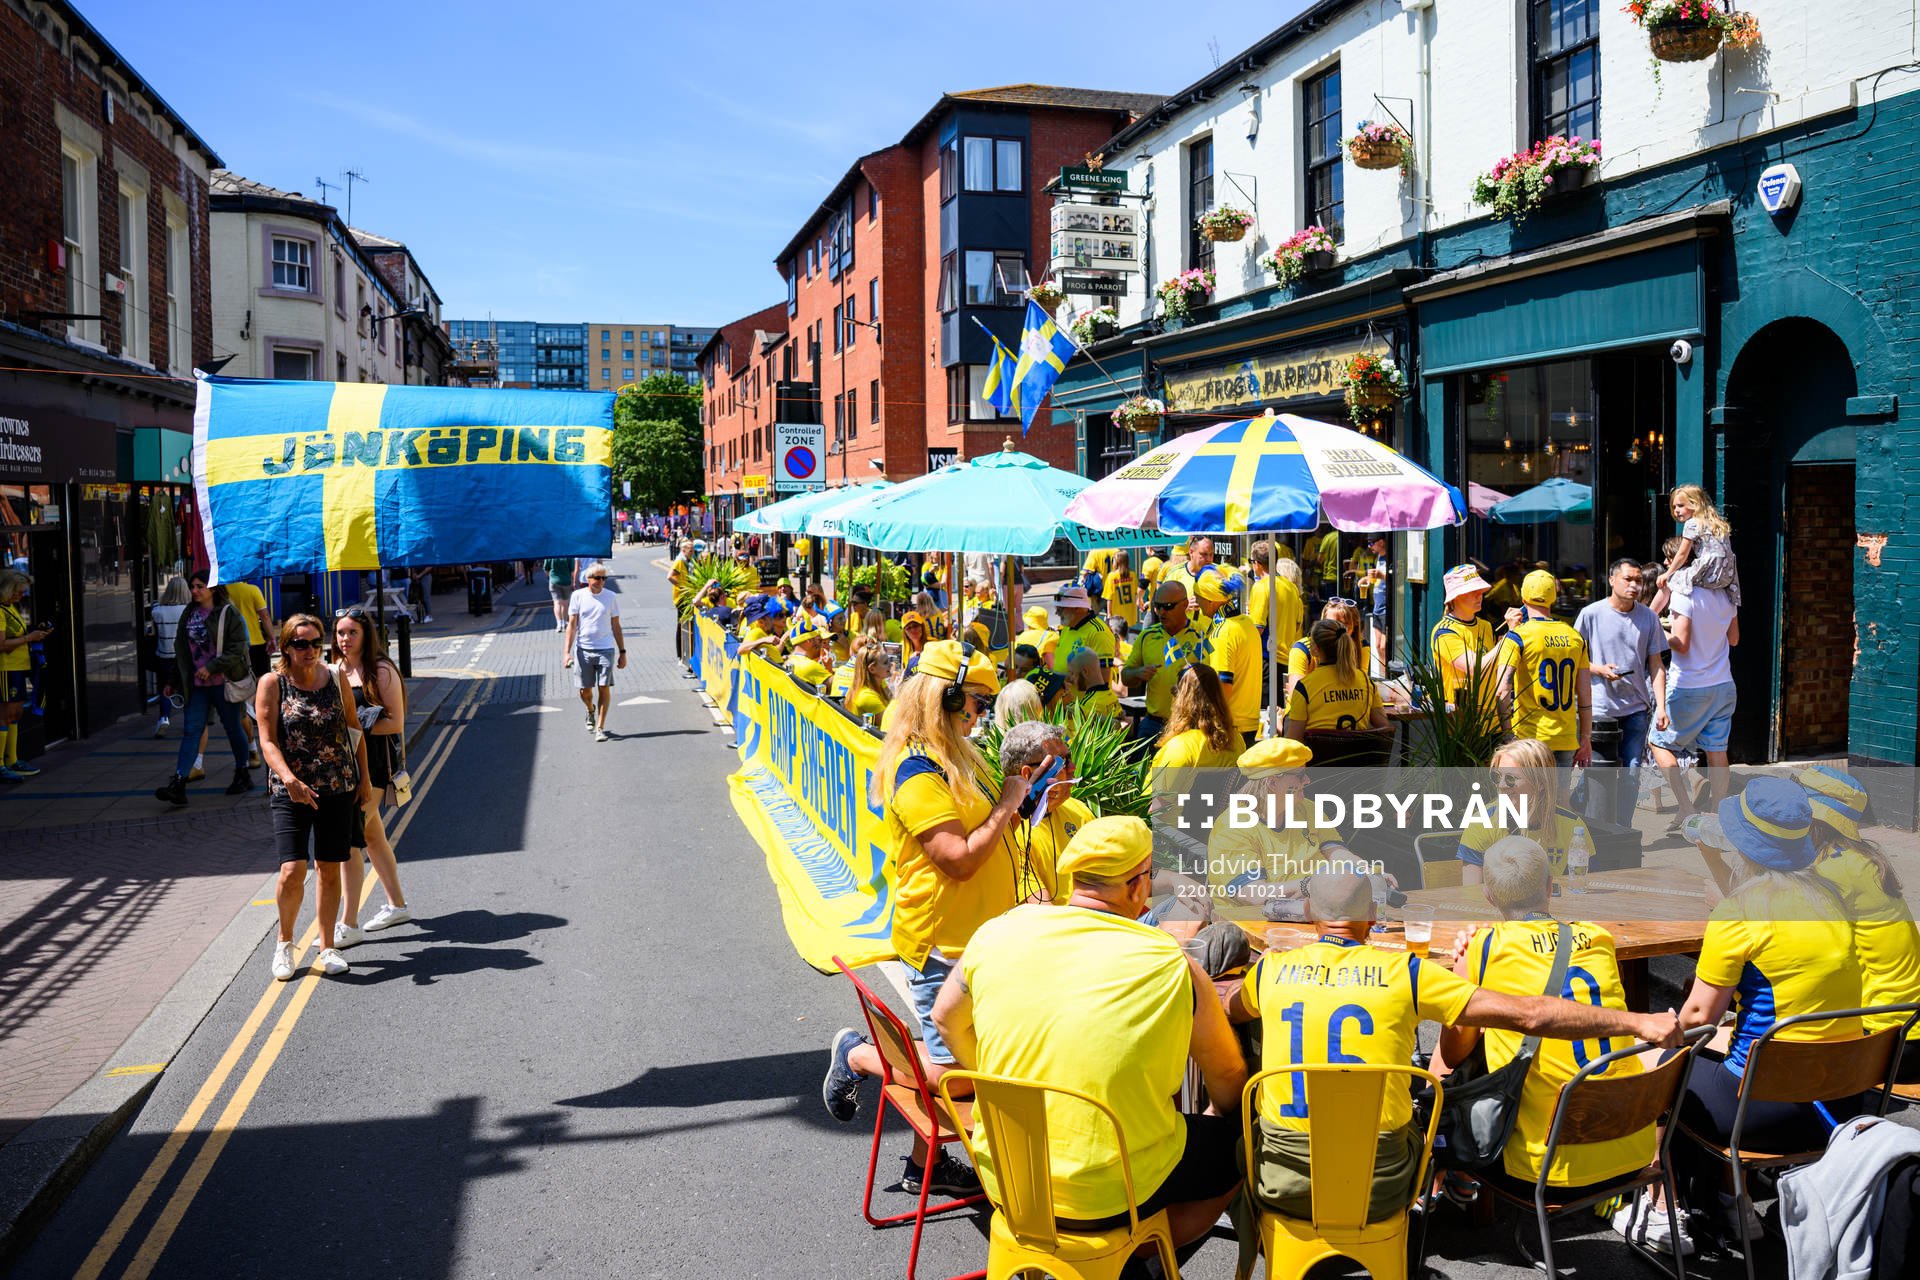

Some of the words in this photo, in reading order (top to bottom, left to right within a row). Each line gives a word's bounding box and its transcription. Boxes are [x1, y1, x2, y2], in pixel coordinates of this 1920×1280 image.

[1069, 173, 1100, 183] GREENE
[1102, 175, 1122, 184] KING
[1066, 282, 1086, 290] FROG
[1095, 283, 1123, 291] PARROT
[1205, 375, 1245, 402] FROG
[1263, 360, 1333, 394] PARROT
[778, 426, 821, 435] Controlled
[785, 436, 815, 446] ZONE
[263, 427, 586, 476] JÖNKÖPING
[744, 479, 753, 487] TO
[754, 479, 765, 487] LET
[1214, 541, 1232, 556] FISH
[1116, 585, 1133, 605] 19
[926, 616, 946, 639] 16
[1544, 635, 1571, 648] SASSE
[1539, 657, 1575, 712] 90
[1323, 688, 1364, 704] LENNART
[768, 688, 797, 785] CAMP
[800, 711, 857, 858] SWEDEN
[1275, 963, 1389, 989] ANGELDAHL
